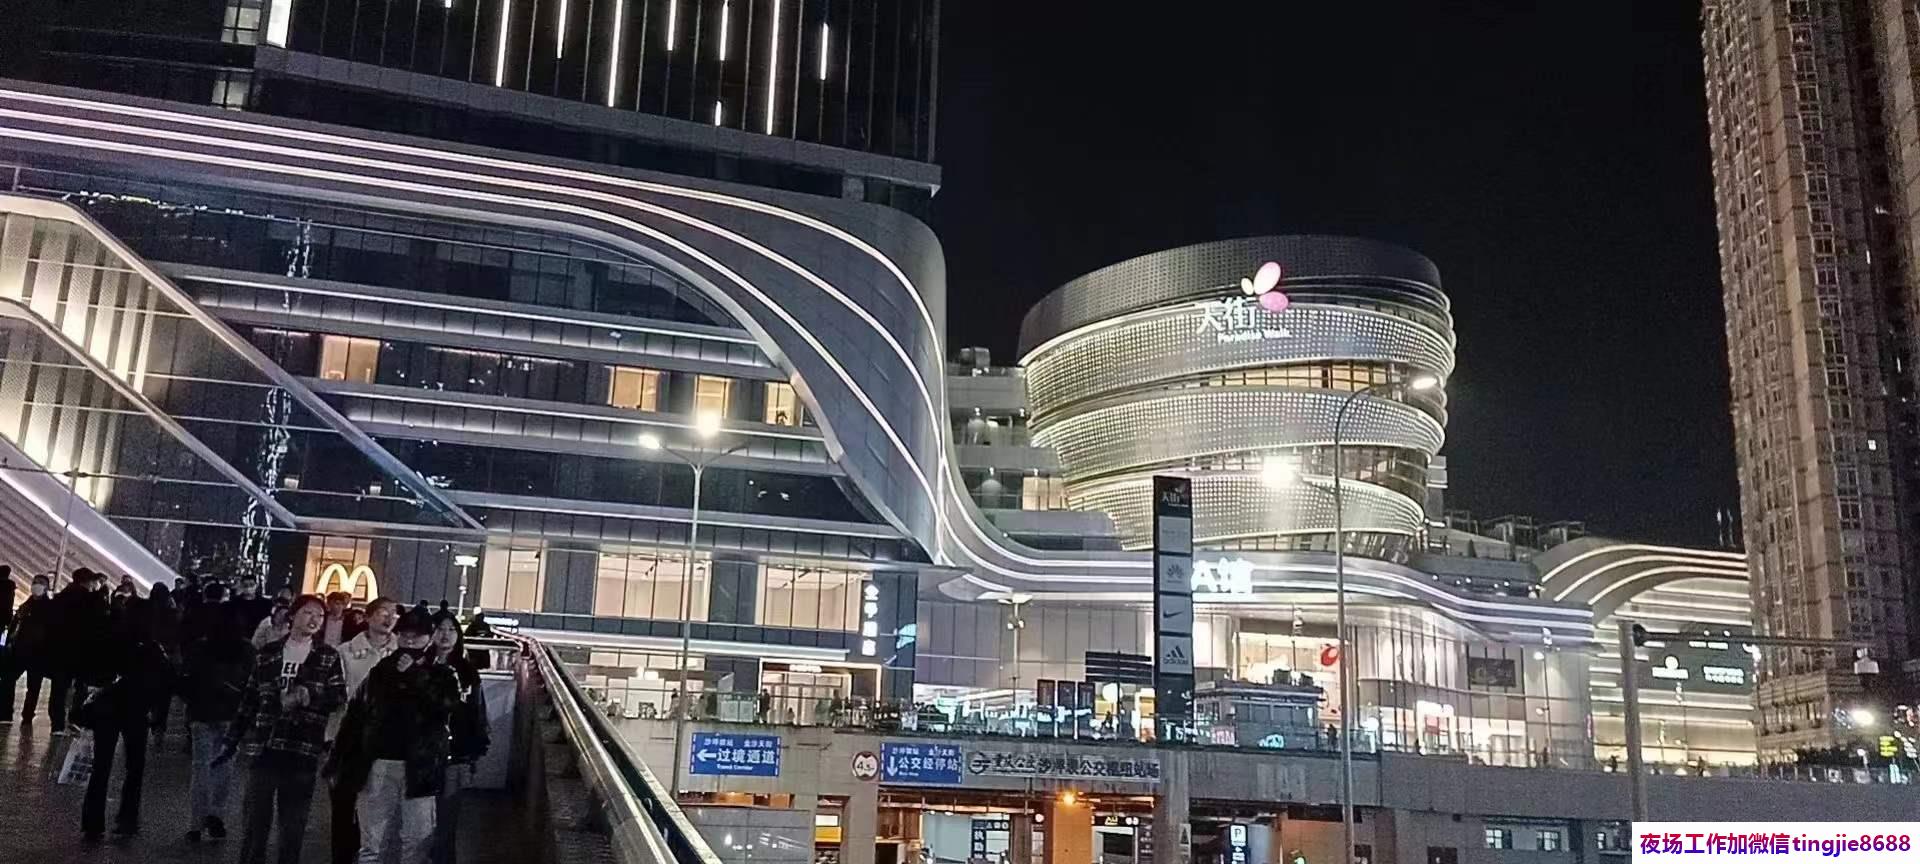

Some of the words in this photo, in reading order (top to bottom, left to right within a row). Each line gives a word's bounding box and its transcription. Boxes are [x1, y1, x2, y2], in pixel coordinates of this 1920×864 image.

[1191, 296, 1257, 335] 天街
[717, 748, 776, 764] 过境通道
[898, 757, 959, 770] 公交经停站
